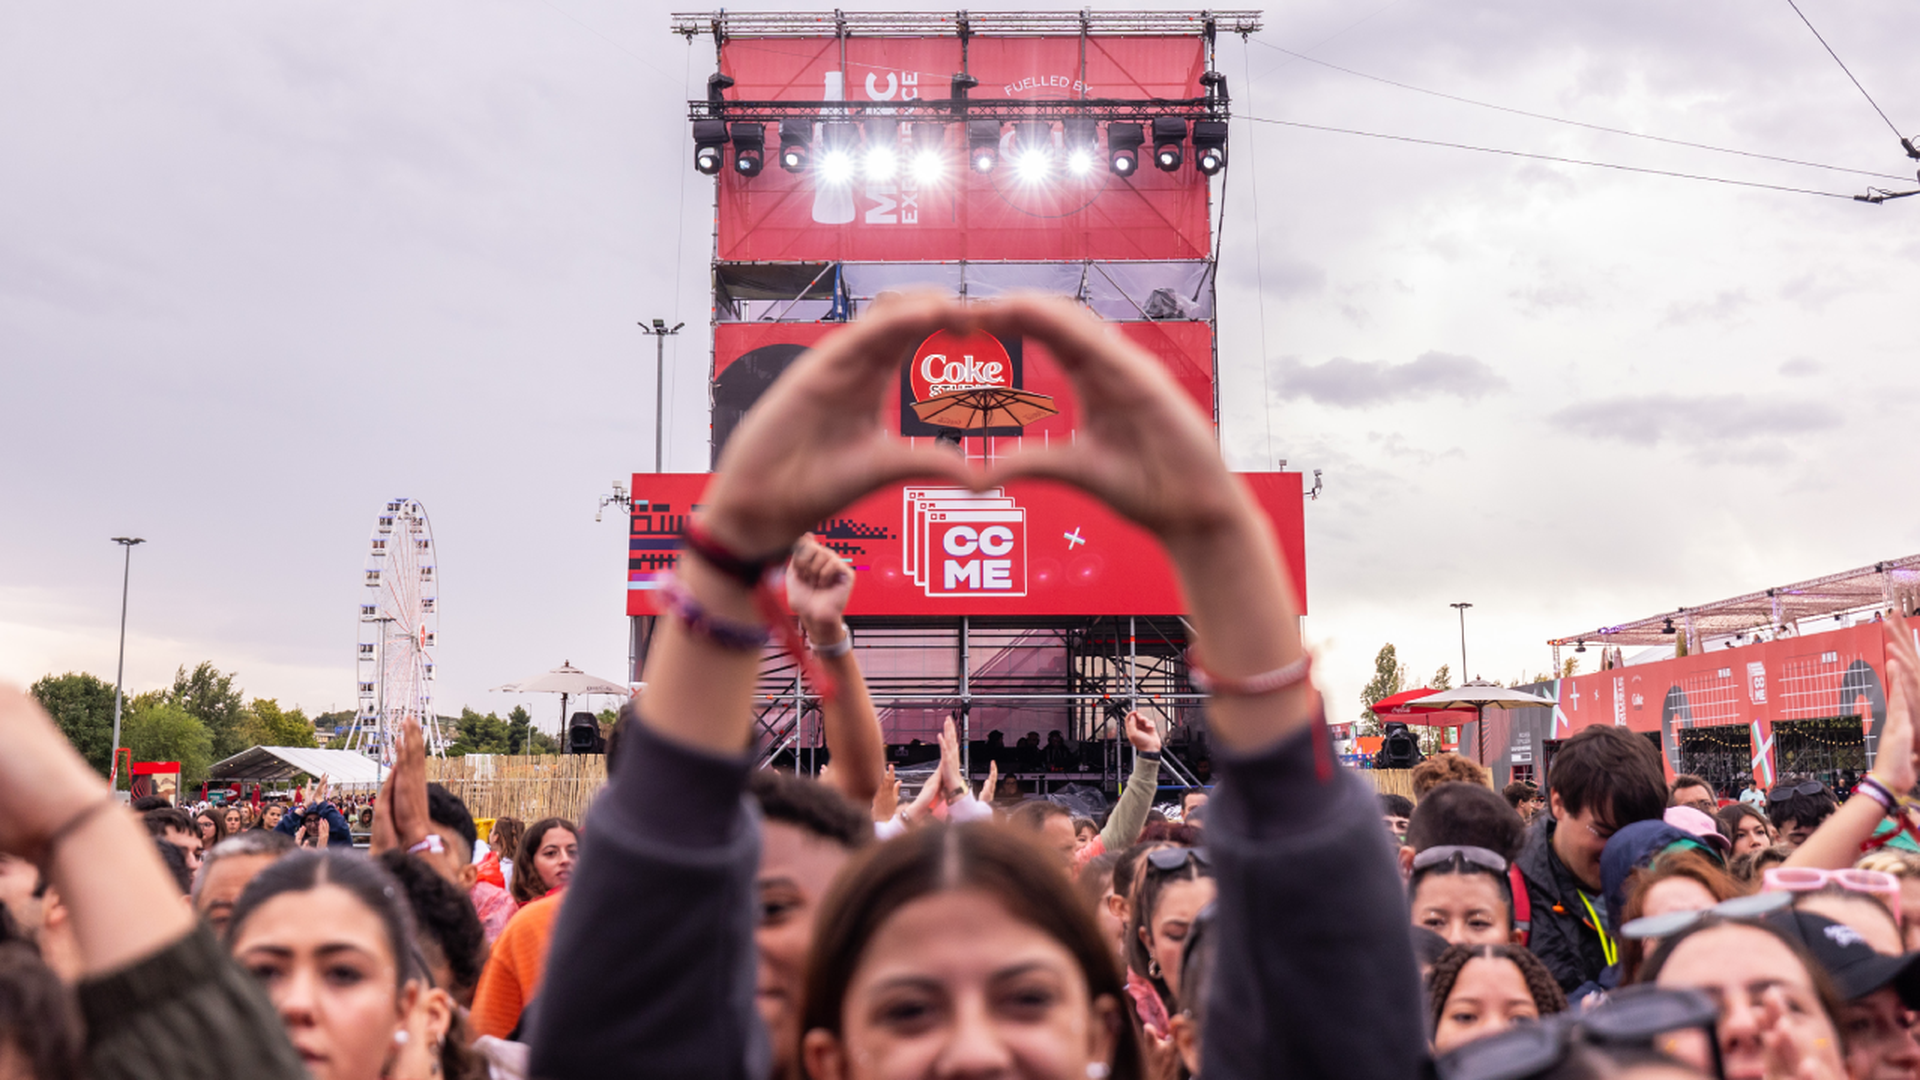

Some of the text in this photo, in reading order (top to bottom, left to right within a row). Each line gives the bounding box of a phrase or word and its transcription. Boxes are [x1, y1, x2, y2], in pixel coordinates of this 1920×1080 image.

[1004, 75, 1093, 97] FUELLED BY
[865, 72, 898, 224] MIC
[920, 354, 1005, 384] Coke
[943, 526, 1014, 557] CC
[944, 560, 1012, 590] ME
